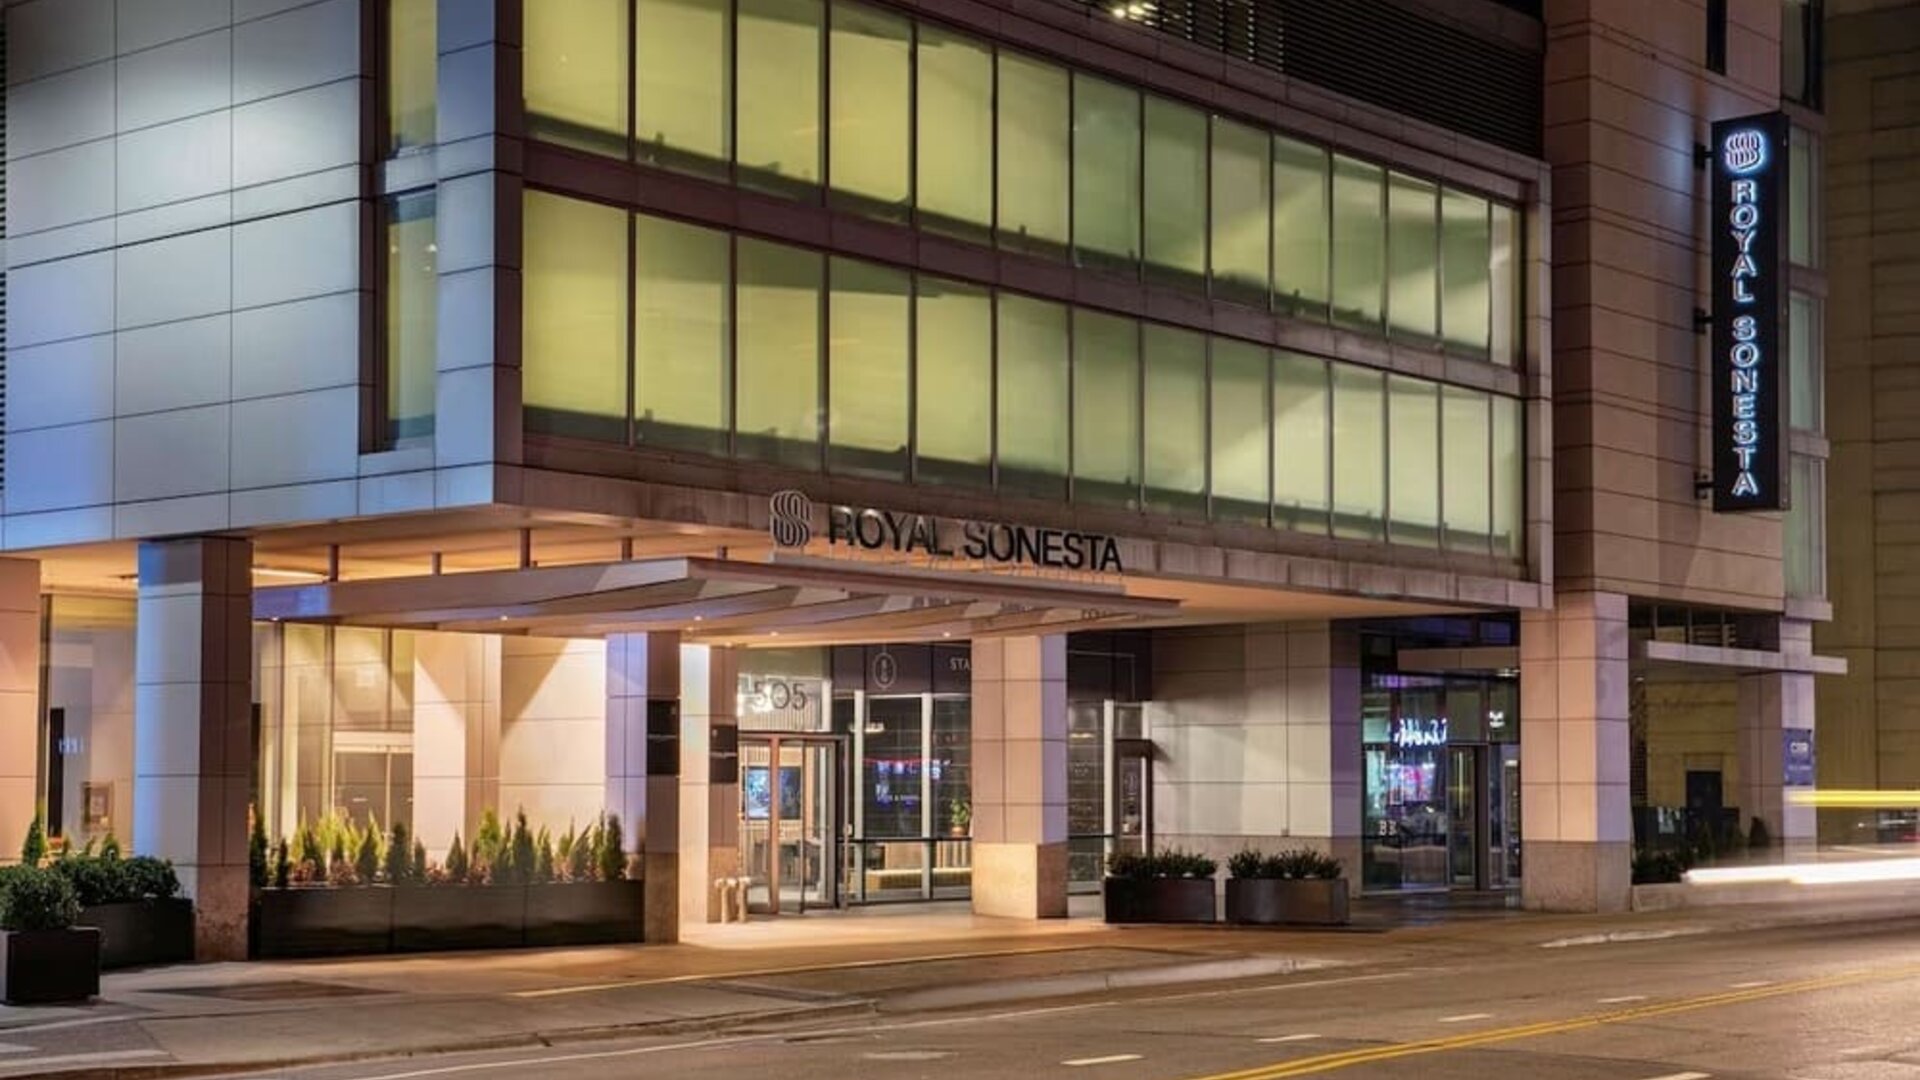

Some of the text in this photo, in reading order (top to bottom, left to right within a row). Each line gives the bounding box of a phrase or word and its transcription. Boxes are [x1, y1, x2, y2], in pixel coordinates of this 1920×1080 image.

[1730, 179, 1760, 497] ROYAL SONESTA
[828, 504, 954, 557] ROYAL
[963, 523, 1124, 573] SONESTA
[753, 680, 807, 711] 505
